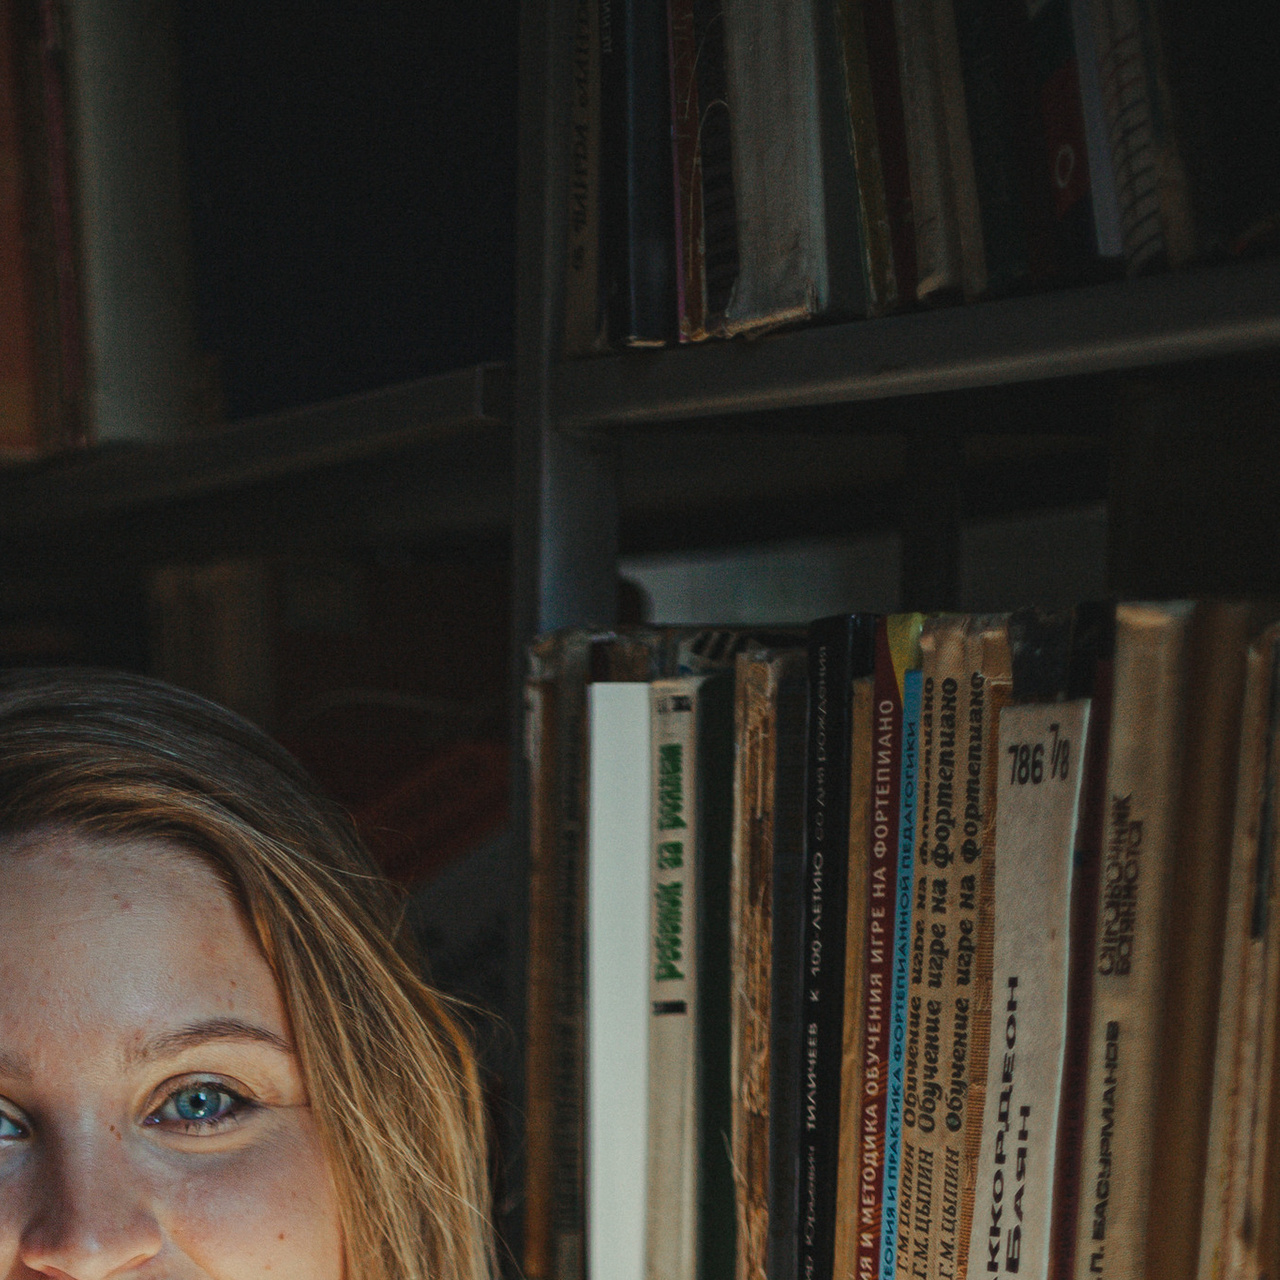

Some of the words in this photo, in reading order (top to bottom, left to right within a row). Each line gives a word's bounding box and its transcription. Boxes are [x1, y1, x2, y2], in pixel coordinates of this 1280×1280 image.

[873, 698, 895, 858] ФОРТЕПИАНО
[900, 719, 917, 867] ПЕДАГОГИКИ
[928, 676, 958, 868] фортепиано
[956, 670, 985, 864] фортепиано
[1008, 742, 1045, 785] 786
[811, 851, 825, 977] 100-ЛЕТИЮ
[870, 906, 887, 964] ИГРЕ
[872, 865, 888, 897] НА
[925, 876, 948, 914] на
[955, 873, 976, 910] на
[809, 989, 821, 1002] К
[893, 874, 912, 1062] ФОРТЕПИАННОЙ
[920, 923, 948, 990] игре
[950, 916, 976, 985] игре
[806, 1023, 818, 1131] ТИЛИЧЕЕВ
[865, 973, 884, 1096] ОБУЧЕНИЯ
[916, 999, 943, 1134] Обучение
[943, 998, 970, 1134] Обучение
[861, 1104, 880, 1225] МЕТОДИКА
[886, 1068, 903, 1180] ПРАКТИКА
[1091, 1020, 1119, 1241] БАСУРМАНОВ
[860, 1233, 875, 1247] И
[885, 1186, 898, 1201] И
[1005, 1105, 1031, 1274] БАЯН
